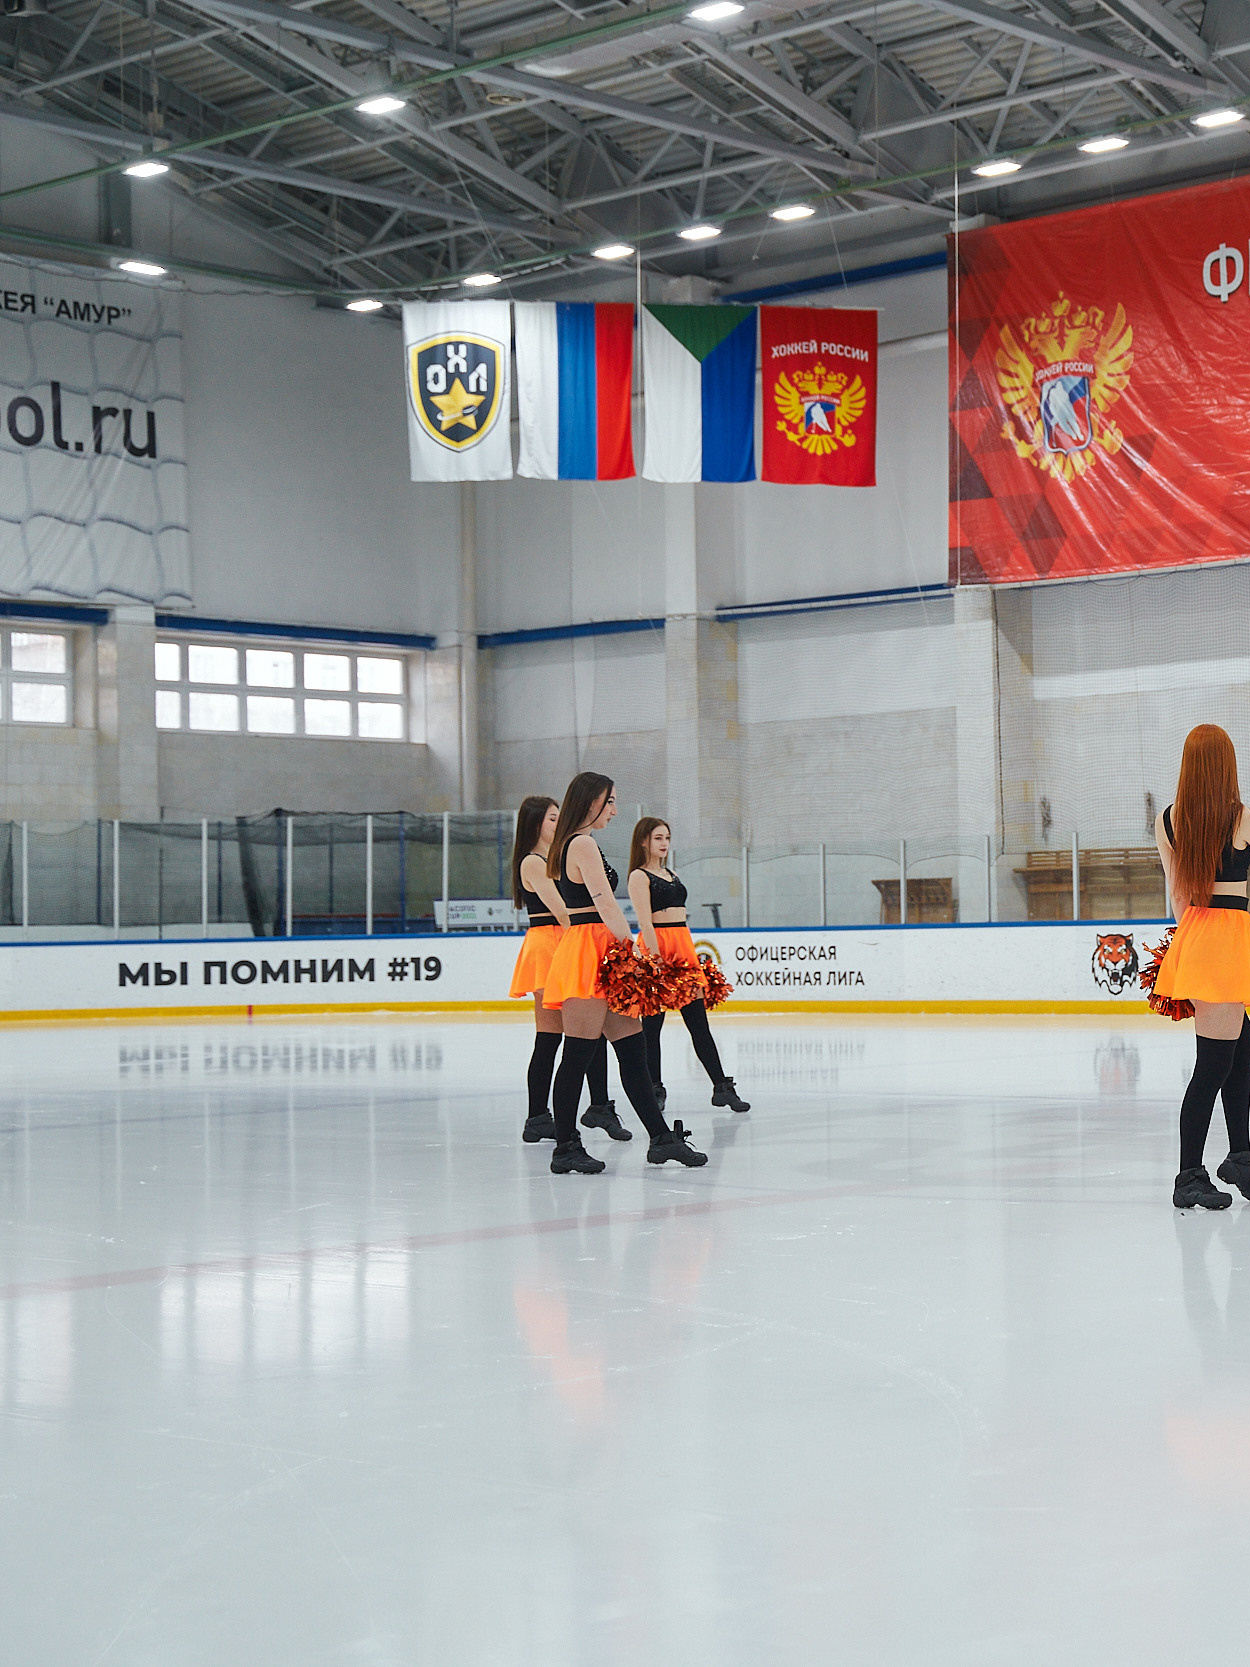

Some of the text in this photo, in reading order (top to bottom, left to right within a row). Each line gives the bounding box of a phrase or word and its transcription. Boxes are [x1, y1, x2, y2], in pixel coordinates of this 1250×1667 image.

[0, 289, 36, 315] ЕЯ
[771, 339, 869, 362] ХОККЕЙ РОССИИ
[7, 381, 157, 458] ol.ru
[735, 945, 837, 963] ОФИЦЕРСКАЯ
[118, 956, 442, 987] МЫ ПОМНИМ #19
[735, 967, 865, 986] ХОККЕЙНАЯ ЛИГА
